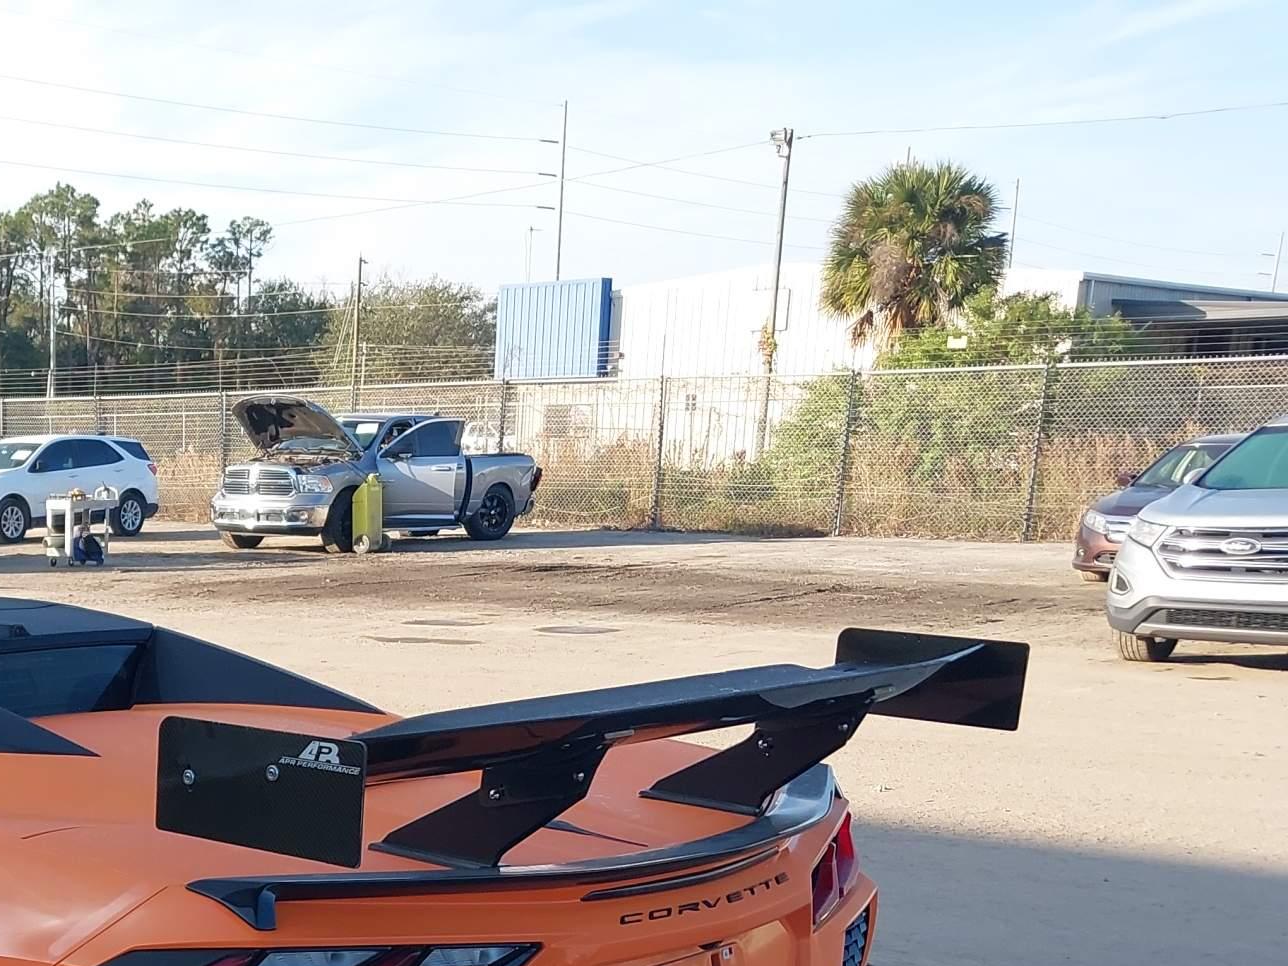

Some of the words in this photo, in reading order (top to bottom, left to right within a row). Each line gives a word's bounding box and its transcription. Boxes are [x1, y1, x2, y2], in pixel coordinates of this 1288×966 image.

[278, 757, 297, 767] APR
[296, 760, 361, 776] PERFORMANCE
[619, 872, 790, 925] CORVETTE
